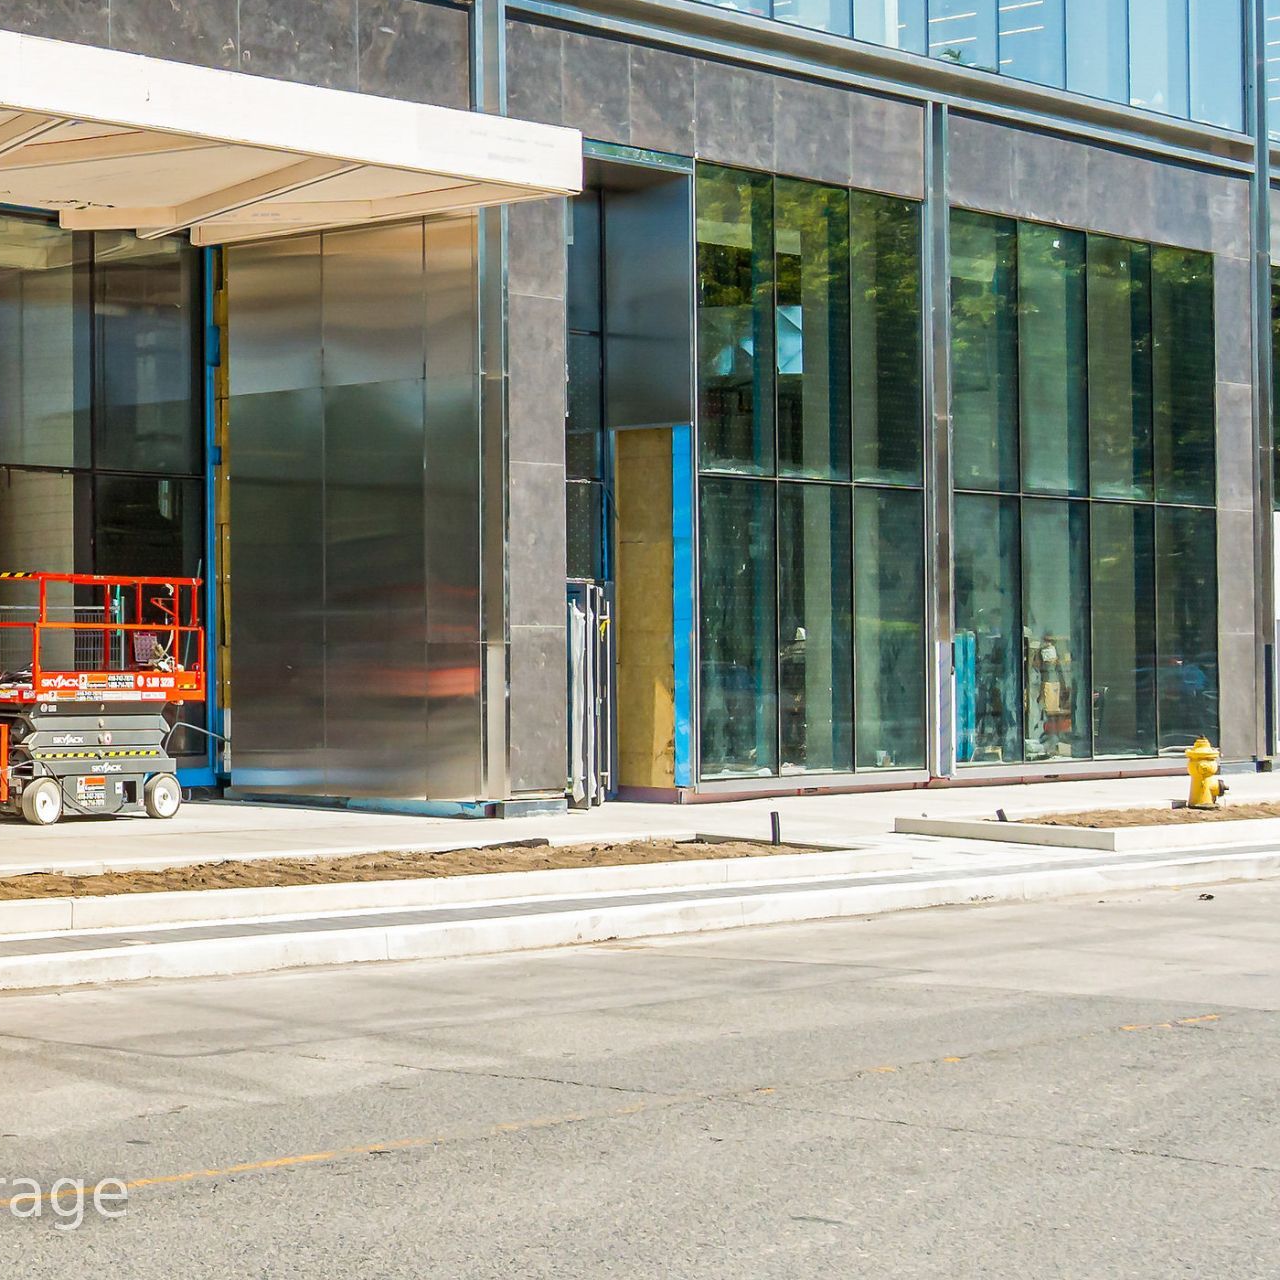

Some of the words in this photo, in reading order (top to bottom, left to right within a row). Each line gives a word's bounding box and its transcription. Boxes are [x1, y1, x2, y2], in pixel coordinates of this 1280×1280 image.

[41, 675, 79, 688] SKYJACK
[53, 734, 84, 745] SKYJACK
[91, 762, 122, 773] SKYJACK
